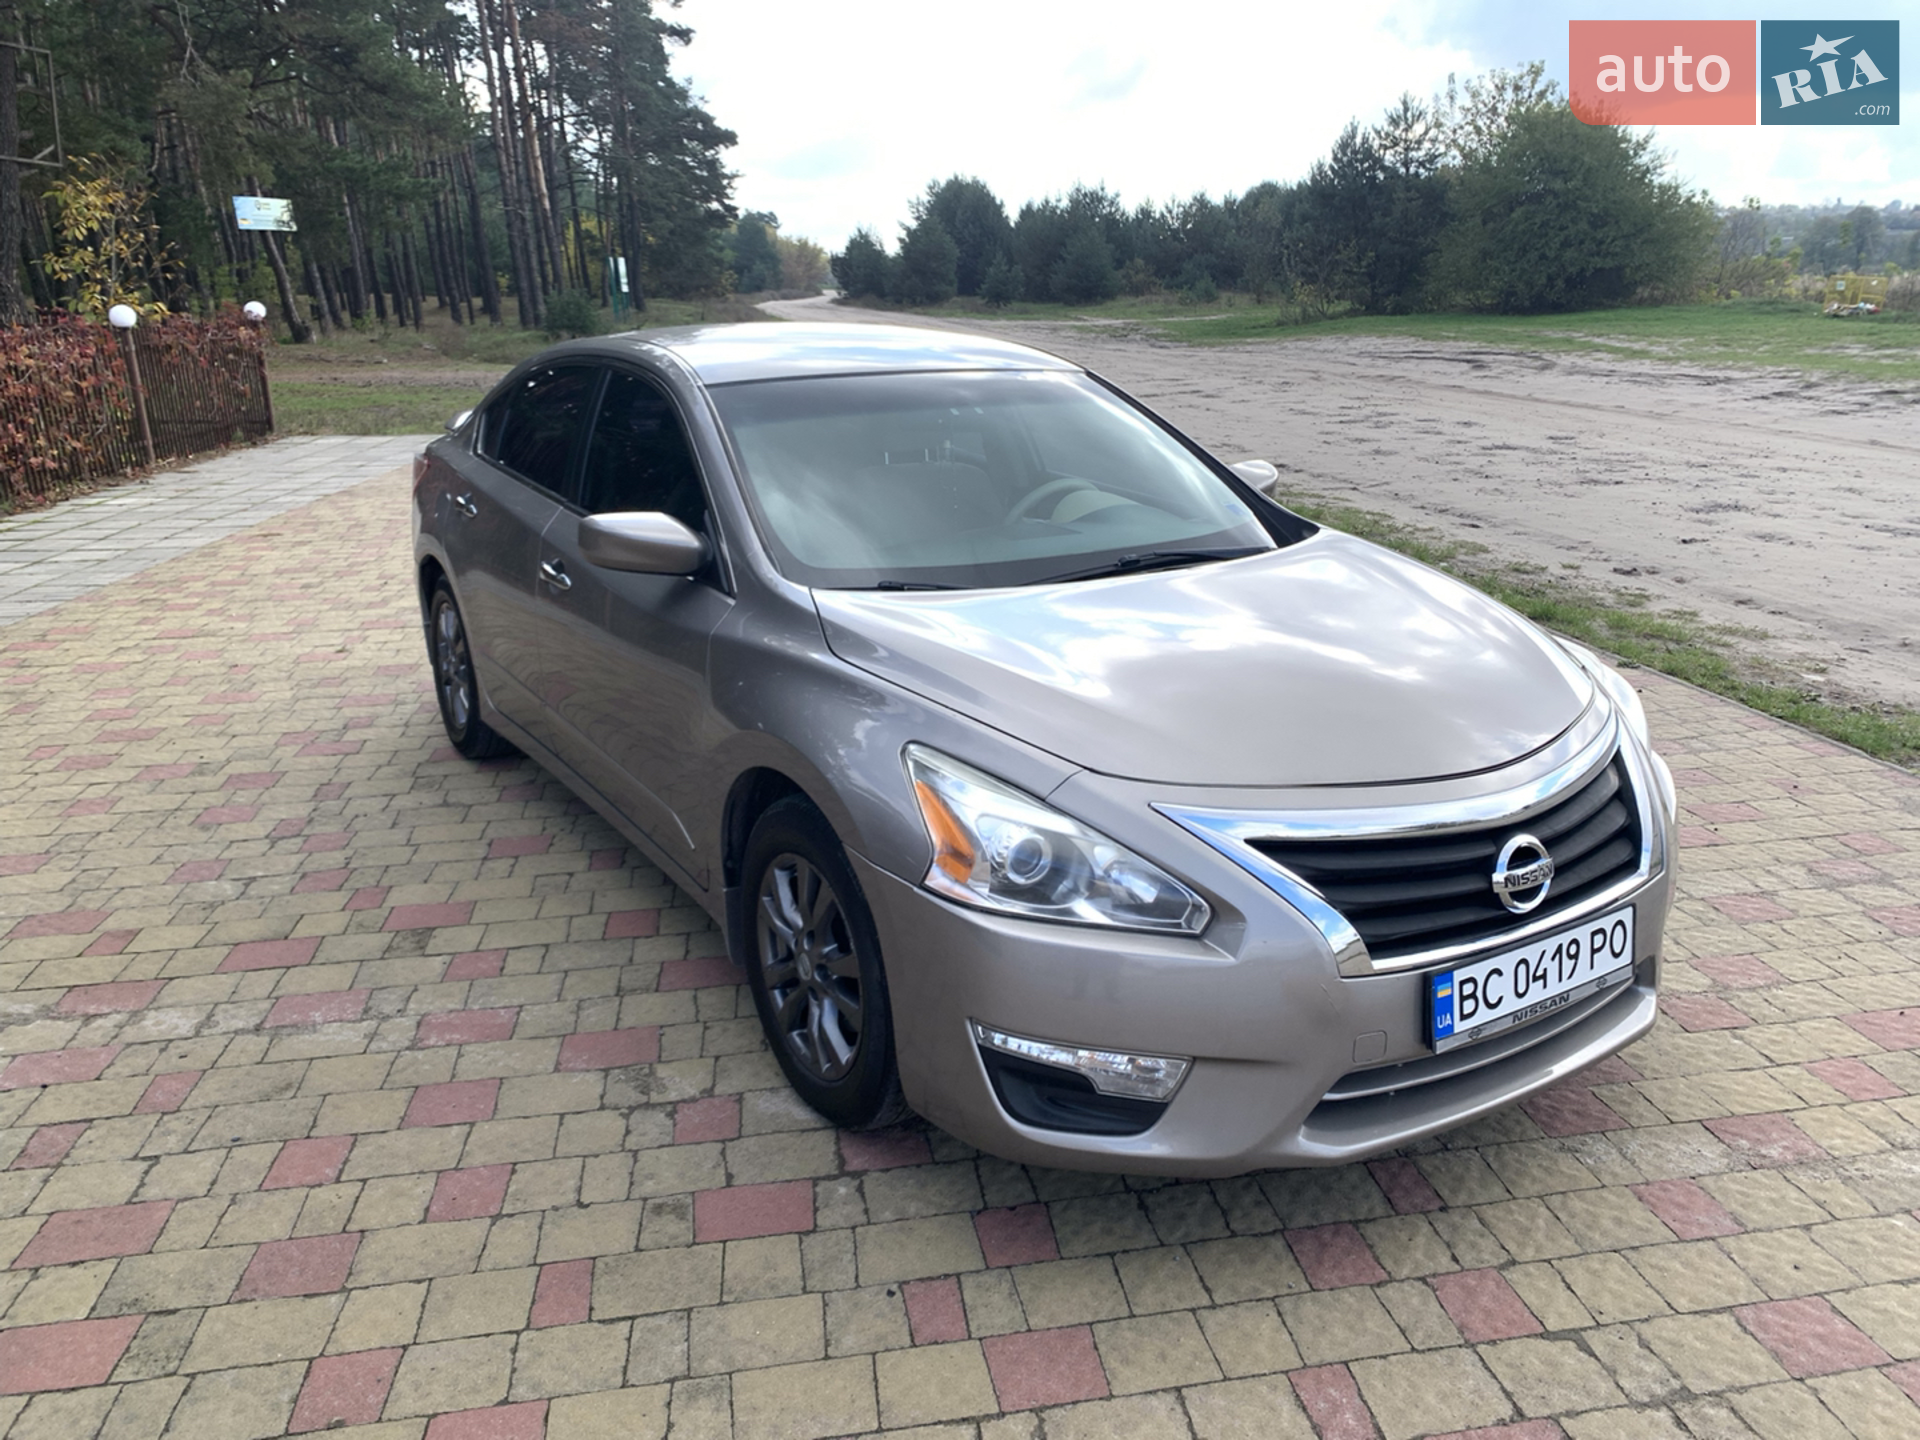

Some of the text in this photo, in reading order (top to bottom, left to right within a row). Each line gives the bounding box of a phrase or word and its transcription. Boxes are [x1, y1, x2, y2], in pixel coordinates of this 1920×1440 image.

[1503, 862, 1554, 889] NISSAN
[1458, 919, 1627, 1022] BC 0419 PO
[1436, 1013, 1453, 1029] UA
[1512, 993, 1571, 1025] NISSAN
